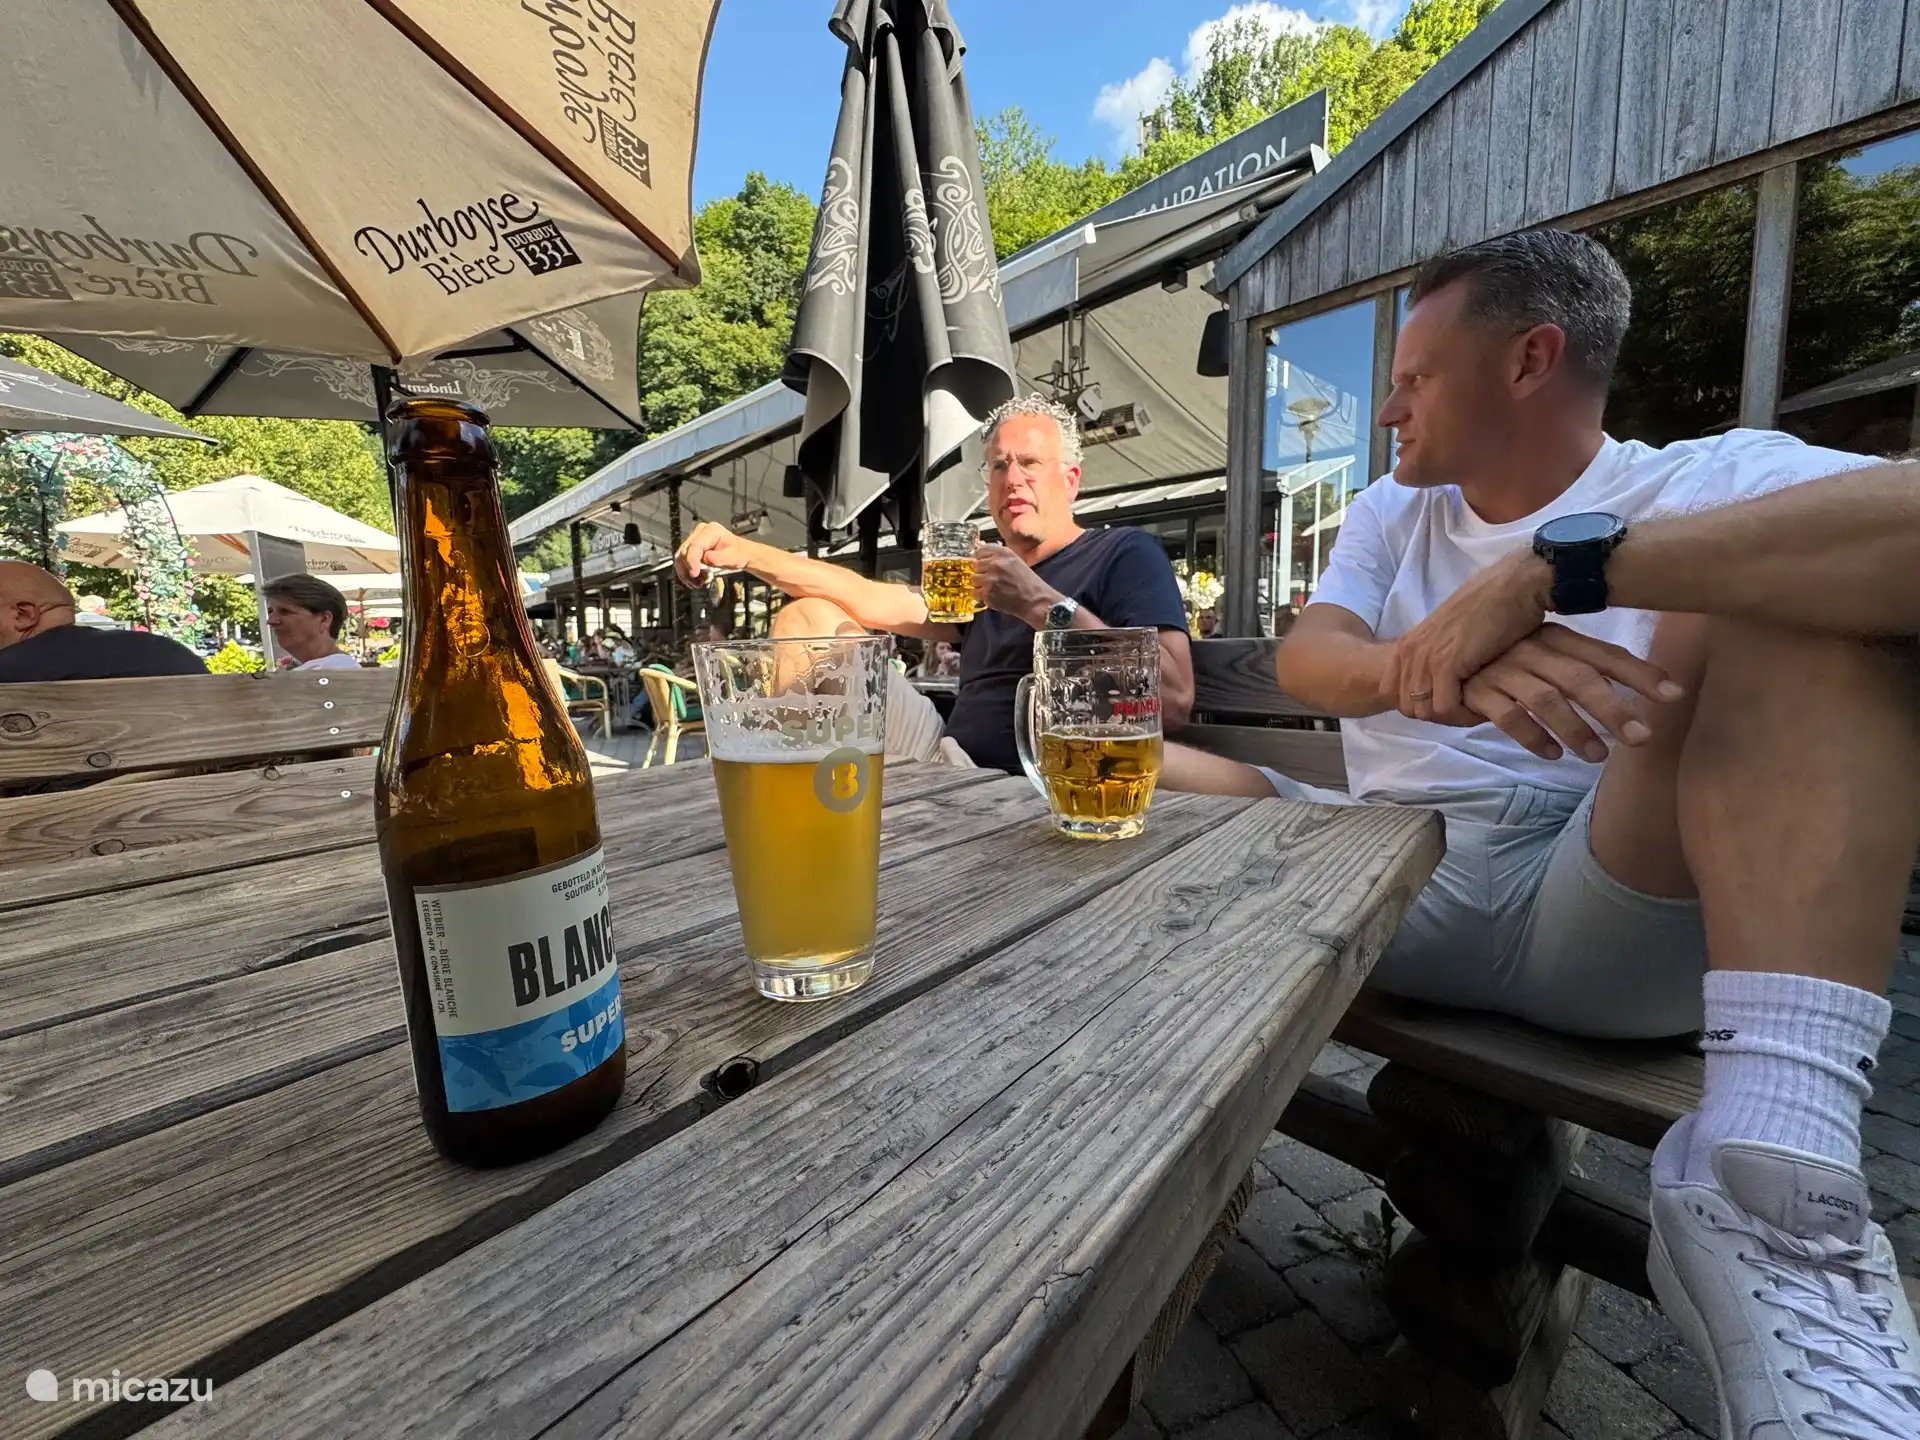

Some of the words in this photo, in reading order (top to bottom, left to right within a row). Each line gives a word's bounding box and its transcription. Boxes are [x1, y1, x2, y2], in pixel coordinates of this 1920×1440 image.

[354, 193, 539, 274] Durboyse
[507, 224, 558, 248] DURBUY
[516, 237, 573, 270] 1331
[421, 252, 515, 295] Bière
[831, 762, 858, 800] 8
[552, 870, 591, 893] GEBOTTELD
[431, 899, 445, 938] WITBIER
[444, 978, 457, 1018] BLANCHE
